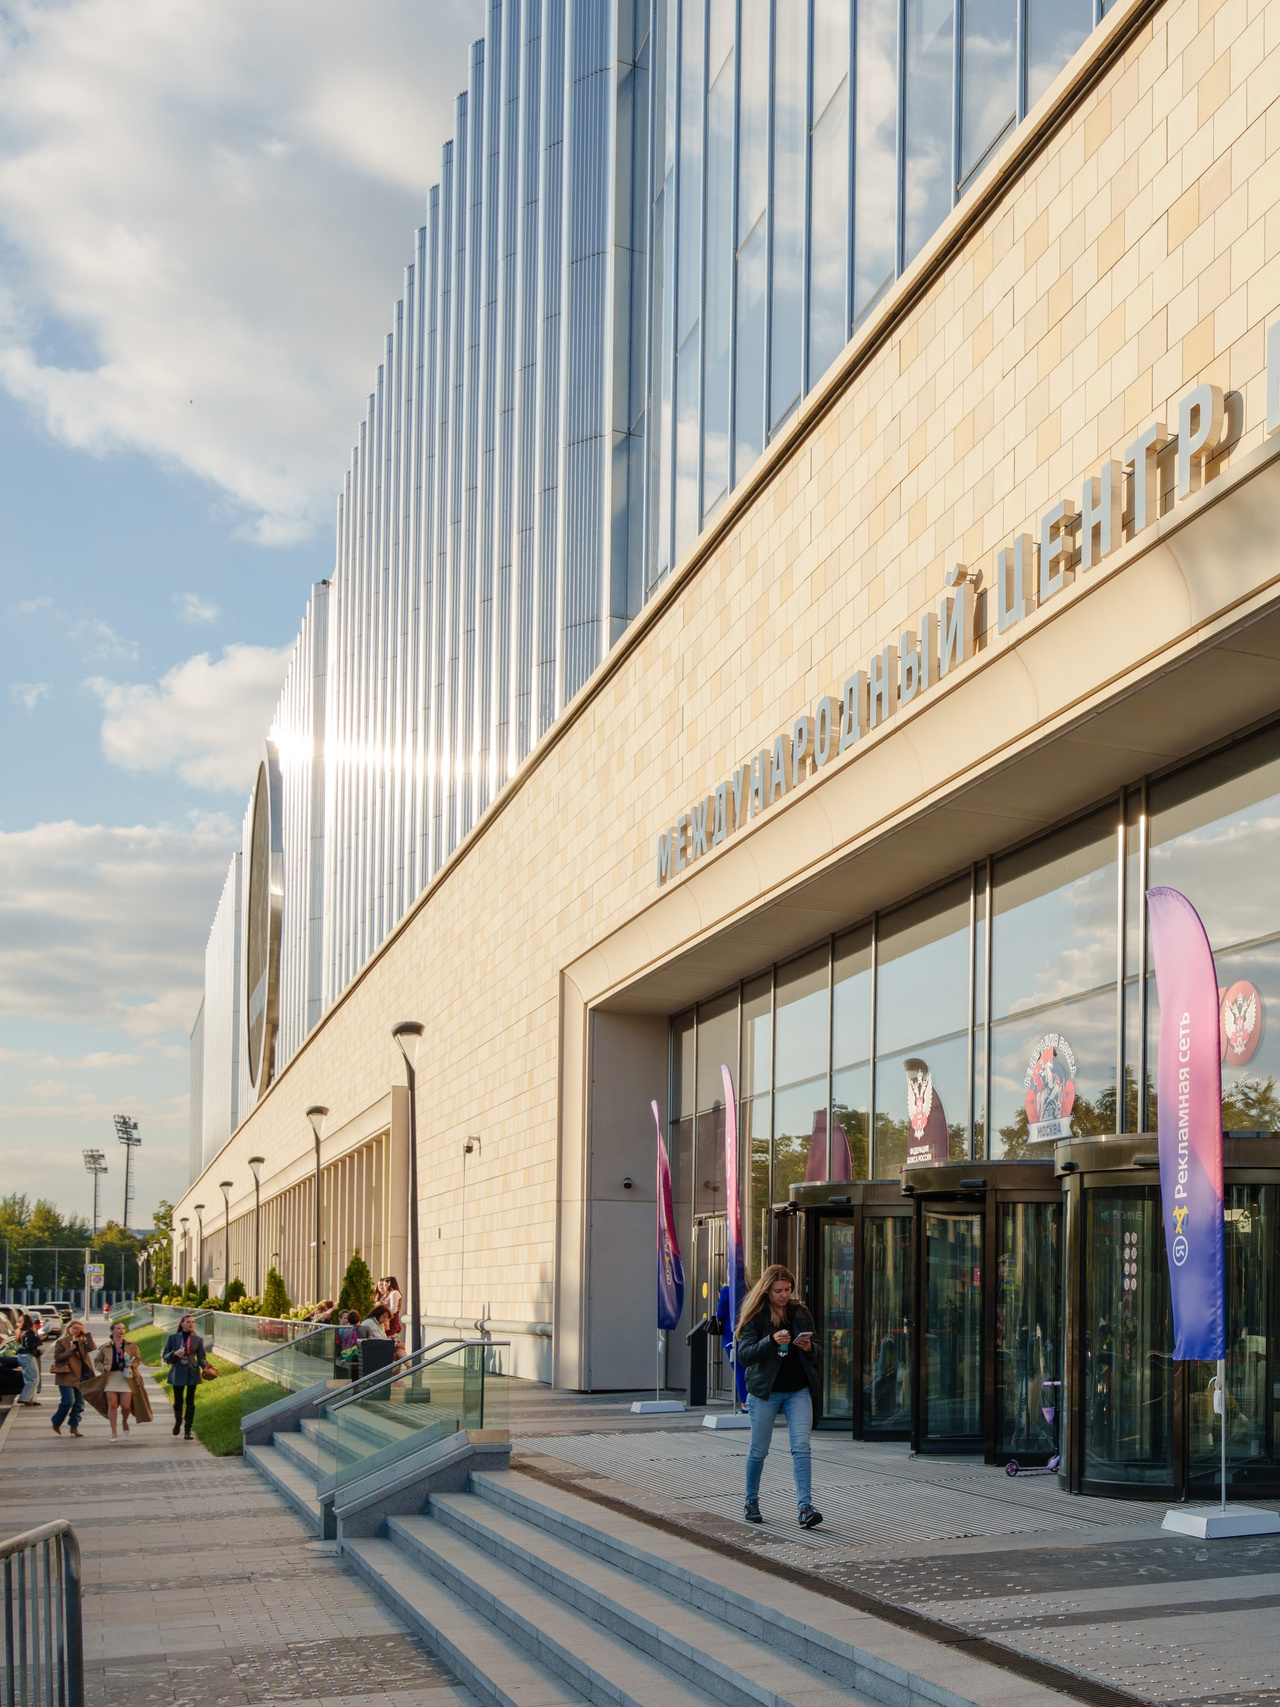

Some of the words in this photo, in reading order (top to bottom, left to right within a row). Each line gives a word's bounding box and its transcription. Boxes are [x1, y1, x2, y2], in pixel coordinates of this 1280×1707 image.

[656, 563, 974, 887] МЕЖДУНАРОДНЫЙ
[998, 383, 1224, 636] ЦЕНТР
[1058, 1036, 1077, 1080] БОКСА
[1178, 1011, 1190, 1063] сеть
[1037, 1123, 1062, 1139] МОСКВА
[1174, 1067, 1190, 1199] Рекламная
